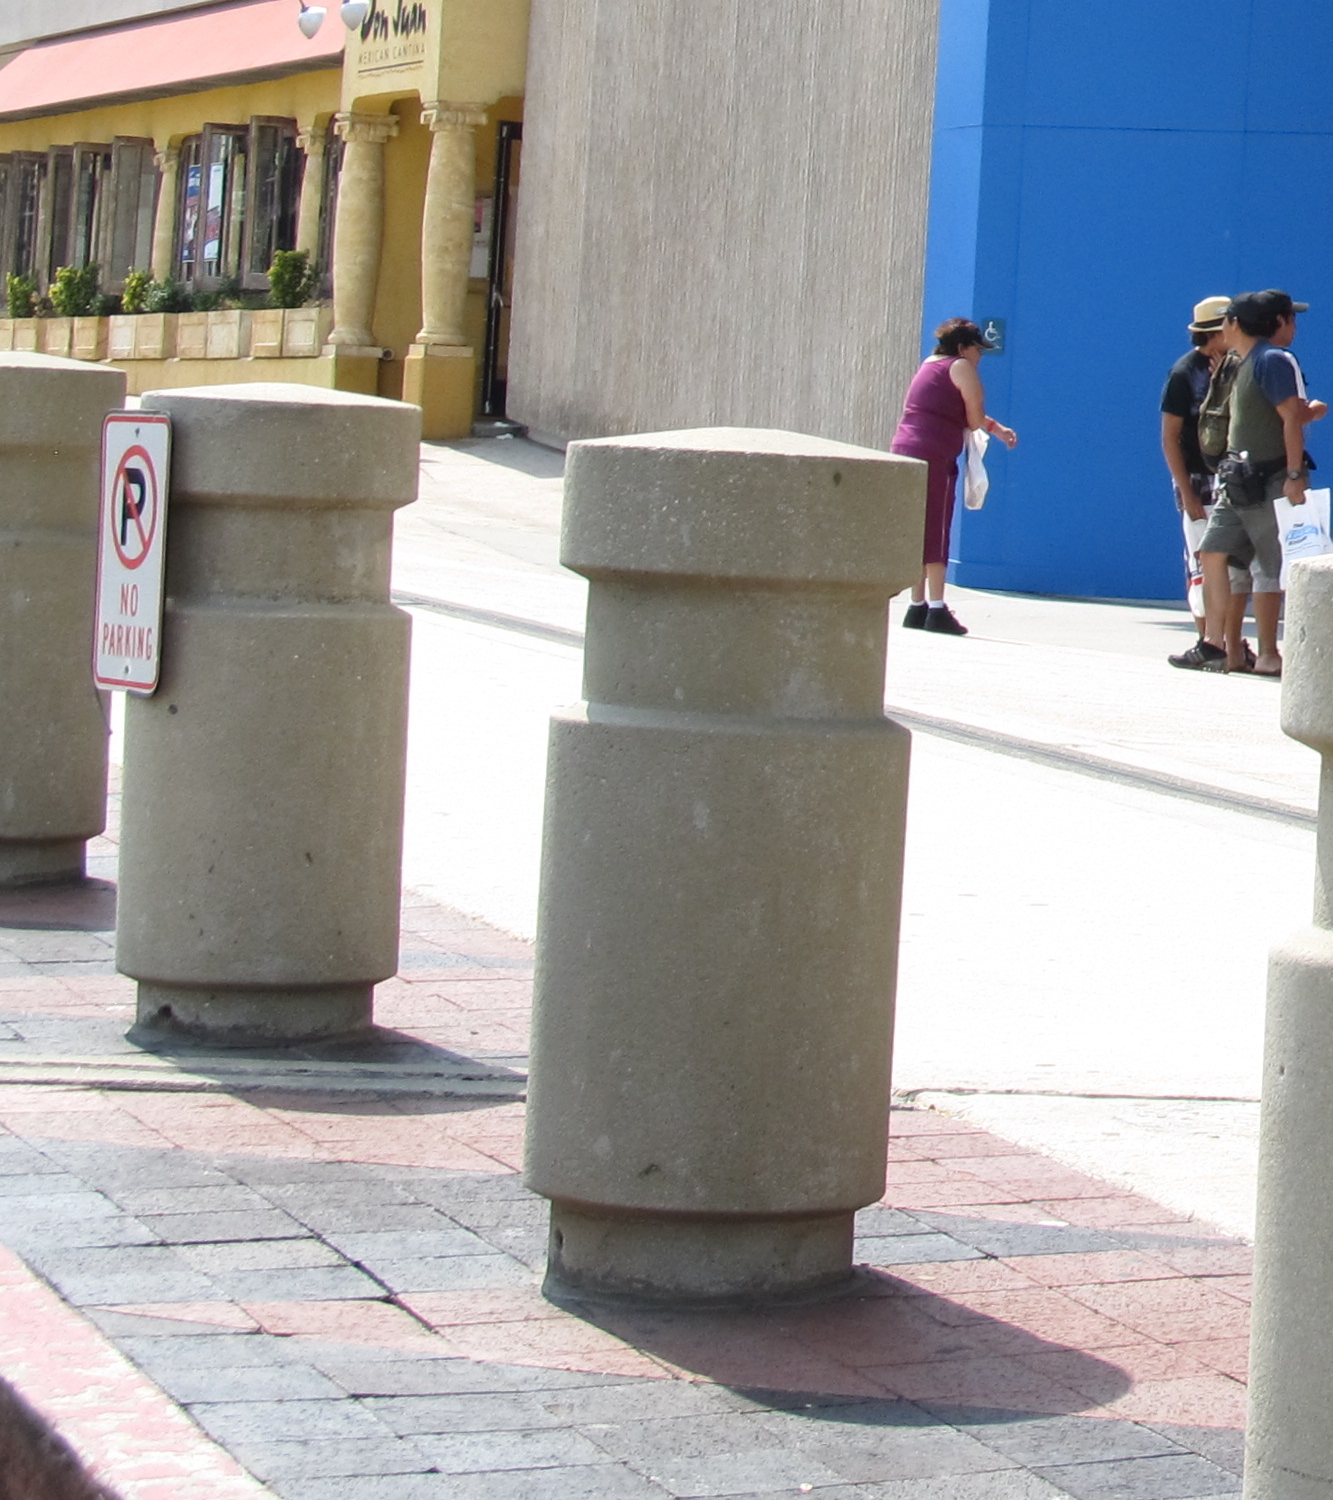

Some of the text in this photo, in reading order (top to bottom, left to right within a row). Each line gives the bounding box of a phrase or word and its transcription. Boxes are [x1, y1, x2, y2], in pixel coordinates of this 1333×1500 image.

[358, 43, 426, 65] MEXICAN CANTINA
[120, 583, 138, 617] NO
[102, 622, 153, 661] PARKING
